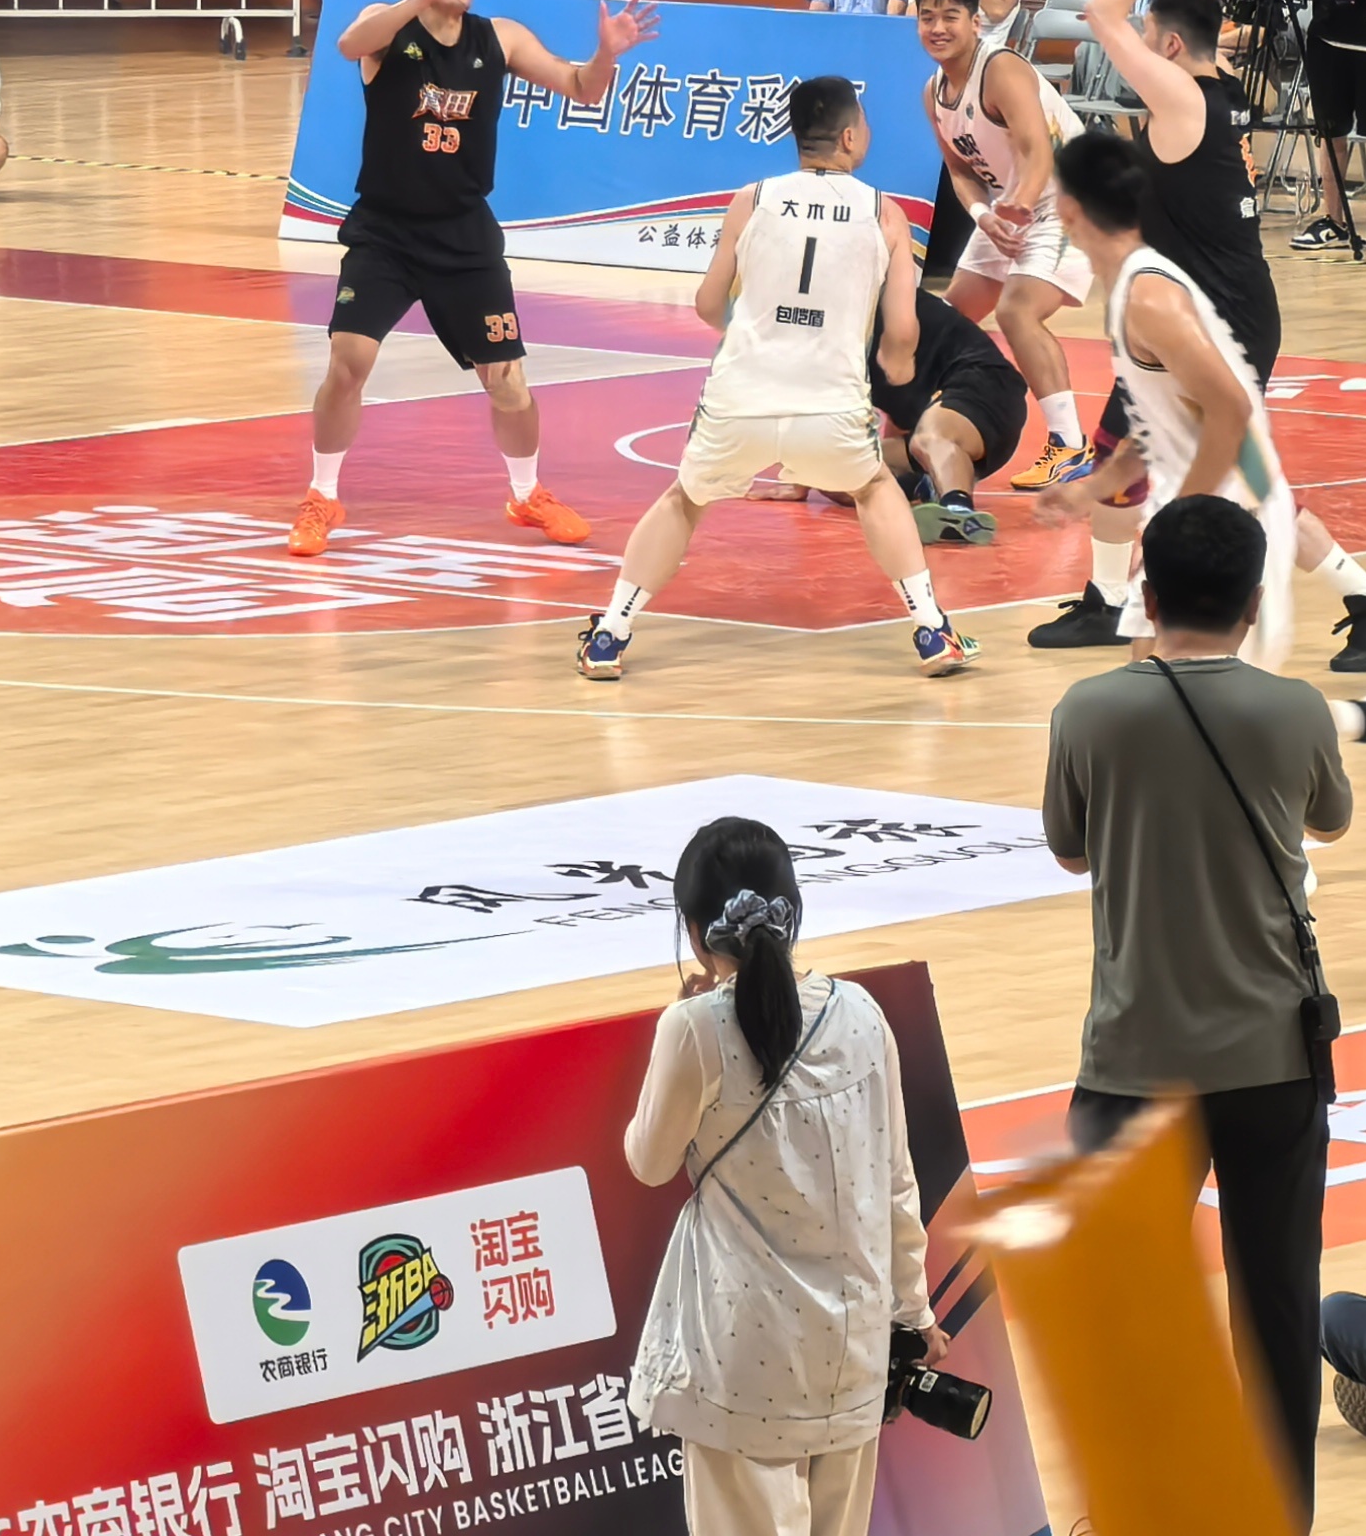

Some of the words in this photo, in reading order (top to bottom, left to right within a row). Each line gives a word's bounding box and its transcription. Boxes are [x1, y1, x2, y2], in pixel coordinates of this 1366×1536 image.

[504, 62, 865, 146] 中国体育彩
[421, 123, 461, 154] 33
[798, 235, 817, 295] 1
[484, 311, 520, 344] 33
[400, 817, 983, 913] 风光旅
[470, 1210, 544, 1273] 淘宝
[482, 1266, 555, 1331] 闪购
[259, 1347, 330, 1383] 农商银行
[252, 1408, 473, 1531] 淘宝闪购
[453, 1462, 617, 1530] BASKETBALL
[626, 1447, 685, 1492] LEAG
